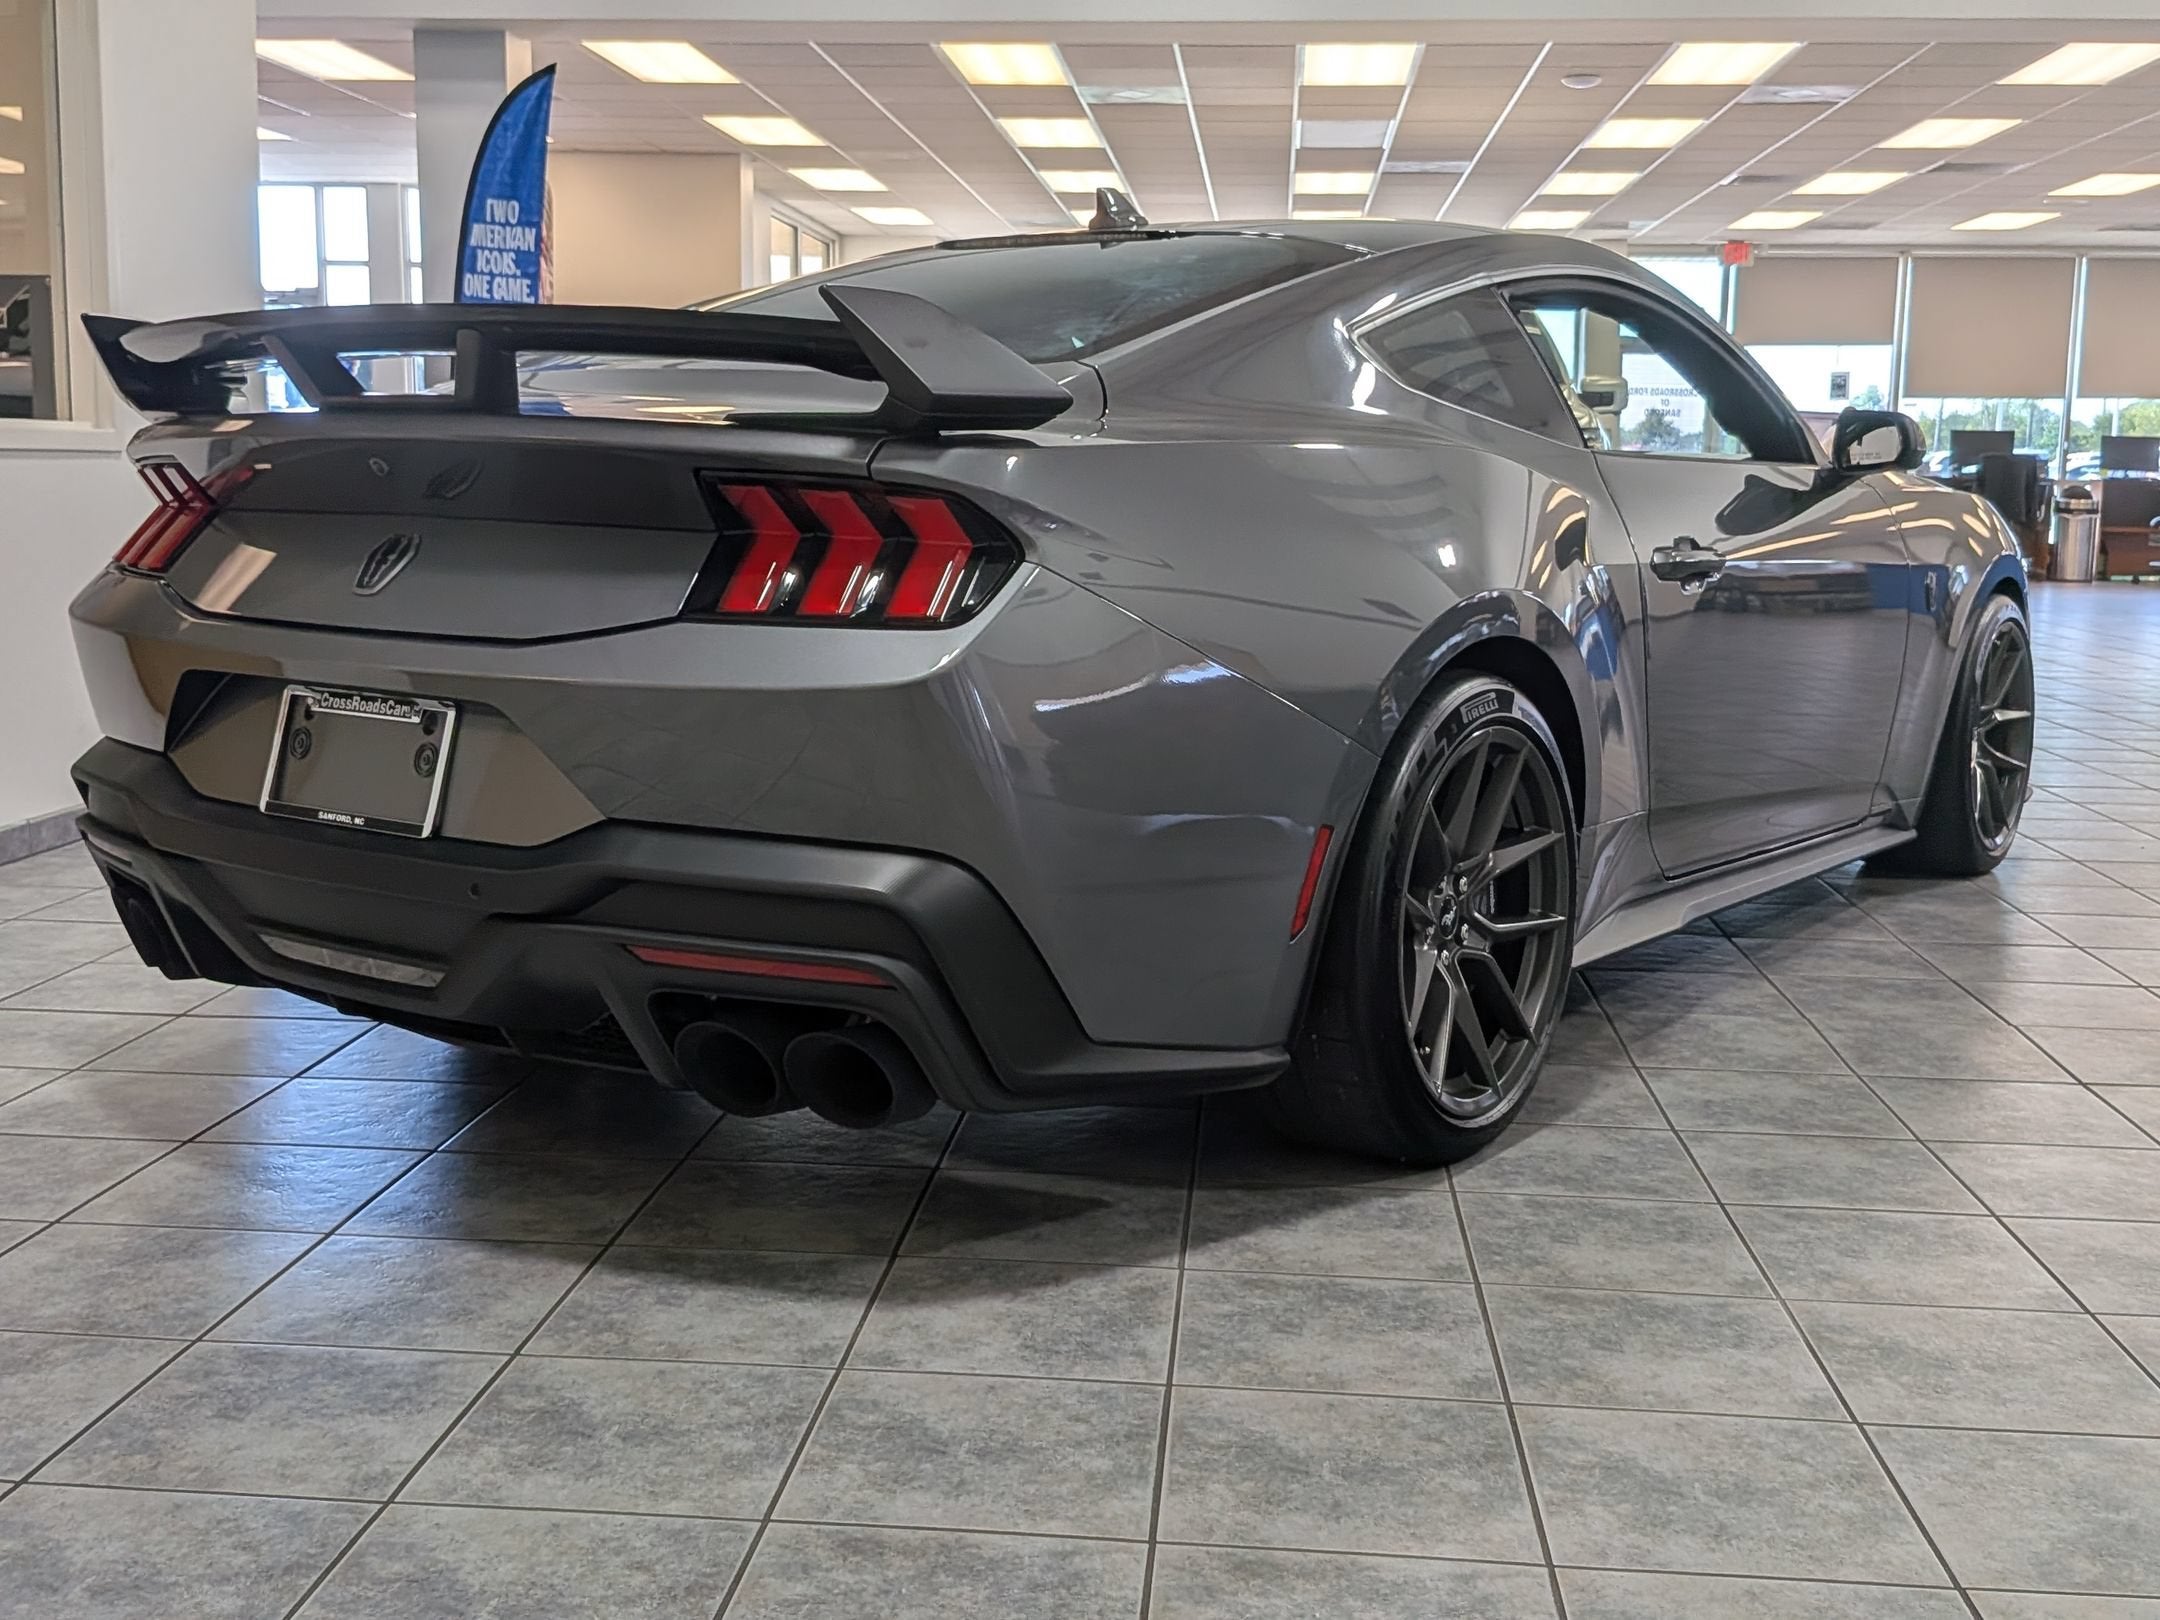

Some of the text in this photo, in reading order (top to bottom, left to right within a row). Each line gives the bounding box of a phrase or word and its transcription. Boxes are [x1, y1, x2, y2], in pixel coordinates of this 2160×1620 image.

[464, 273, 492, 299] ONE
[1459, 691, 1499, 725] PIRELLI
[353, 816, 366, 826] NC
